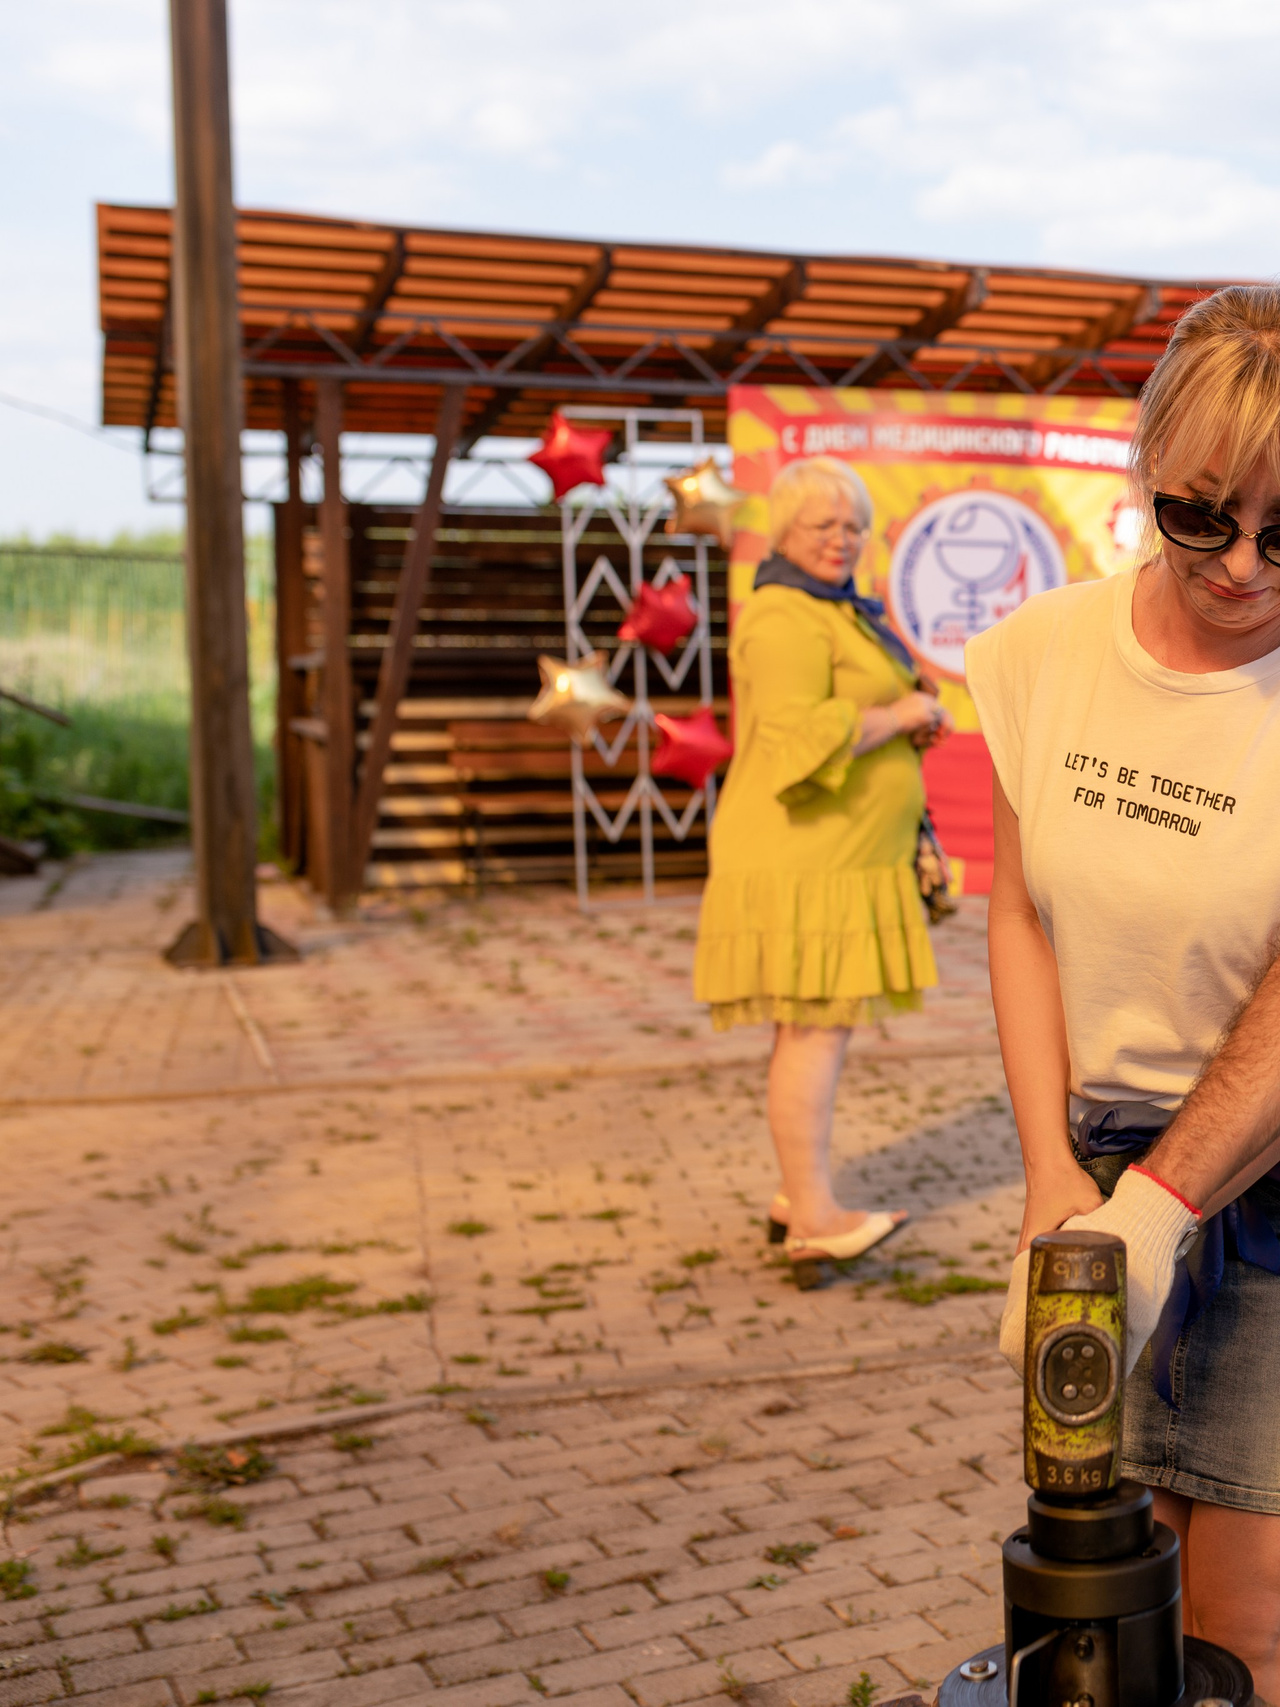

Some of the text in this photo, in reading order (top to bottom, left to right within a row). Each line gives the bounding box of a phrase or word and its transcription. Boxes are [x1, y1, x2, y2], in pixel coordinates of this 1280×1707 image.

[781, 424, 800, 455] С
[1043, 431, 1133, 470] РАБОТН
[1064, 752, 1237, 815] LET'S BE TOGETHER
[1073, 786, 1202, 837] FOR TOMORROW
[1091, 1260, 1107, 1281] 8
[1080, 1466, 1102, 1488] kg
